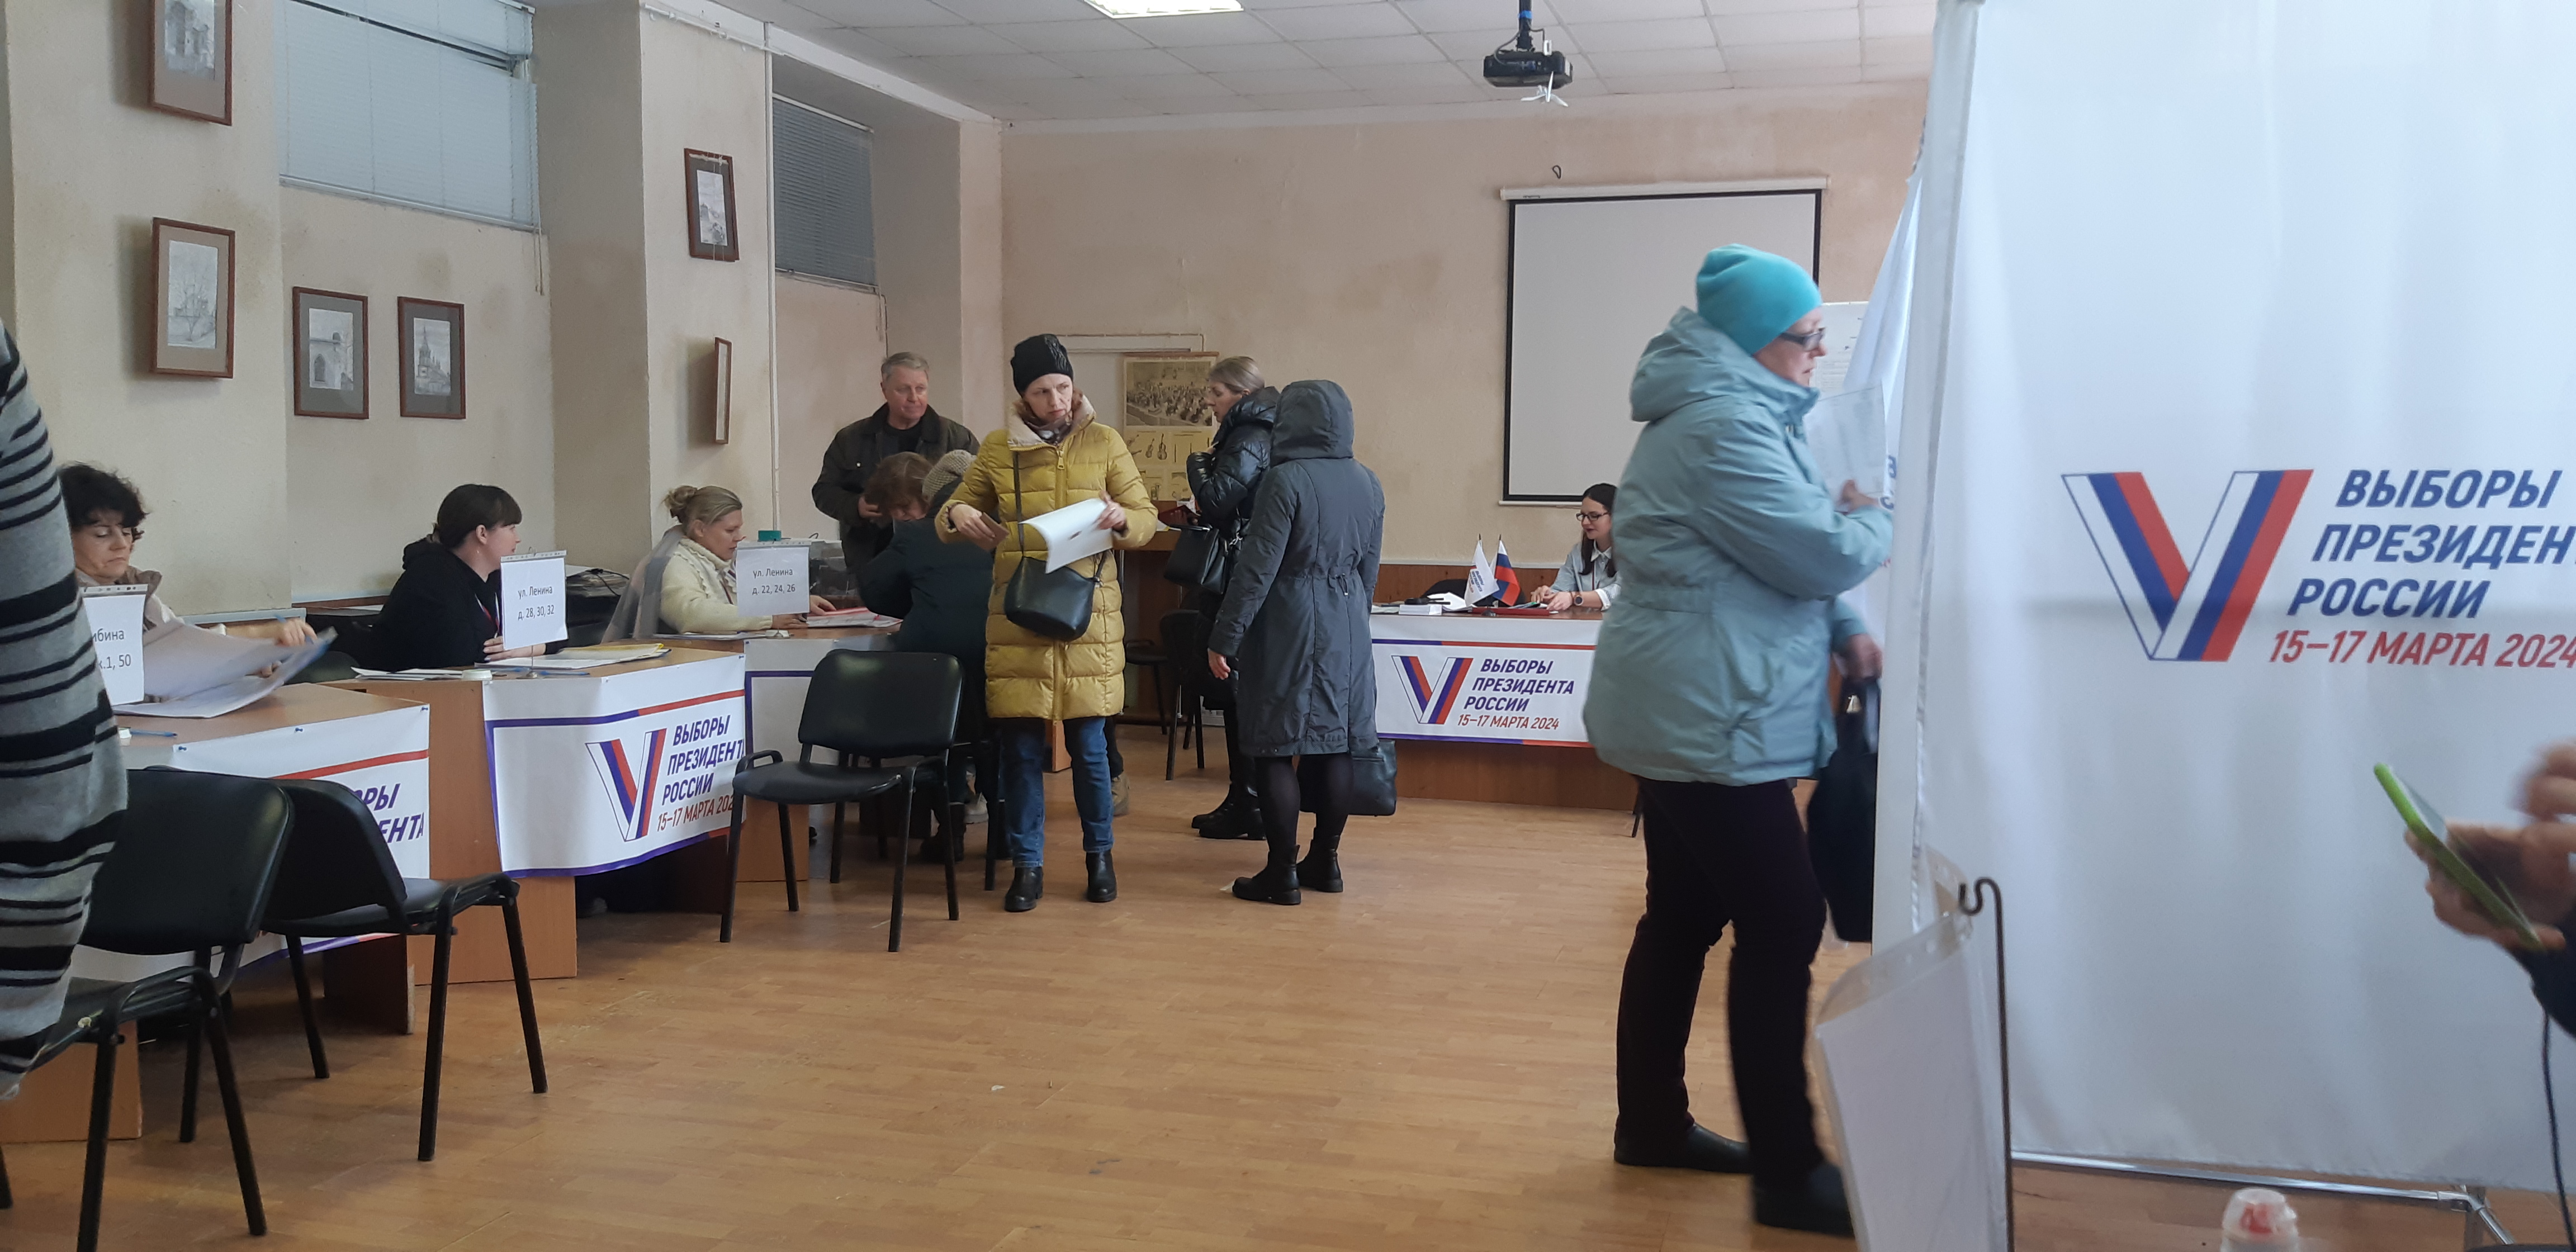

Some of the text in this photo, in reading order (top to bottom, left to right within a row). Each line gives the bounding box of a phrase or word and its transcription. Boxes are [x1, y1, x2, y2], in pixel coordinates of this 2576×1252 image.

[2336, 470, 2563, 508] ВЫБОРЫ
[2312, 524, 2576, 570] ПРЕЗИДЕН
[518, 586, 552, 600] ул. Ленина
[761, 585, 772, 594] 22,
[774, 585, 784, 594] 24,
[2287, 578, 2490, 618] РОССИИ
[518, 605, 554, 620] д. 28, 30, 32
[2366, 631, 2490, 666] МАРТА
[119, 654, 131, 667] 50
[1480, 659, 1554, 674] ВЫБОРЫ
[1472, 677, 1574, 695] ПРЕЗИДЕНТА
[1464, 696, 1530, 712] РОССИИ
[673, 715, 731, 746] ВЫБОРЫ
[1489, 716, 1530, 728] МАРТА
[1531, 718, 1559, 729] 2024
[662, 772, 714, 805] РОССИИ
[683, 798, 715, 824] МАРТА
